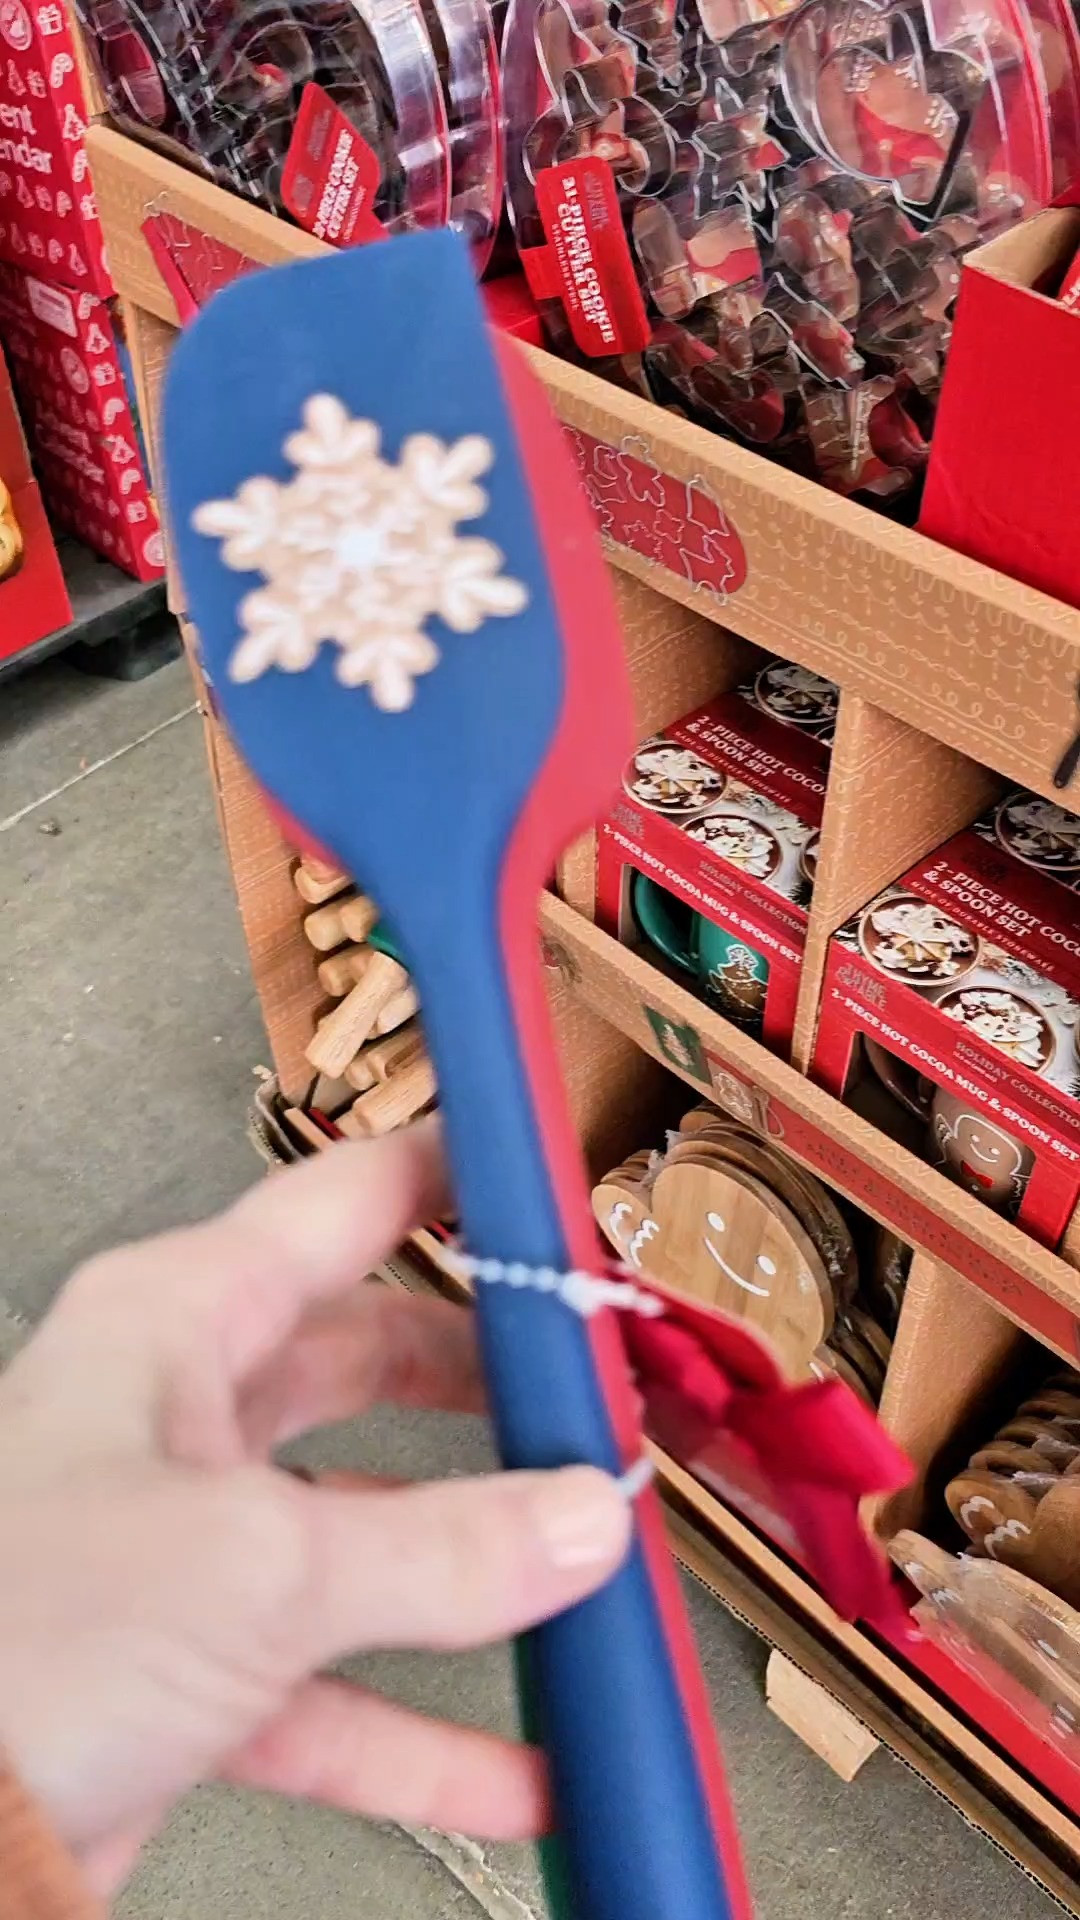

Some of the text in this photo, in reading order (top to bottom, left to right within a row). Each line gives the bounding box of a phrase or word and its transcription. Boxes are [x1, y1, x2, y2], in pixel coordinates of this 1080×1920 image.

[327, 184, 352, 238] CUTTER
[342, 156, 359, 188] SET
[558, 203, 600, 324] CUTTER SET
[584, 267, 616, 343] COOKIE
[675, 731, 697, 746] MADE
[696, 745, 709, 753] OF
[686, 722, 775, 777] & SPOON SET
[751, 749, 786, 769] HOT
[641, 851, 665, 873] HOT
[664, 866, 702, 899] COCOA
[701, 893, 730, 917] MUG
[729, 911, 740, 925] &
[739, 919, 780, 950] SPOON
[779, 945, 802, 963] SET
[700, 860, 744, 893] HOLIDAY
[744, 890, 808, 935] COLLECTION
[911, 881, 1056, 972] MADE OF DURABLE STONEWARE
[923, 870, 1032, 937] & SPOON SET
[1000, 901, 1042, 927] HOT
[880, 1022, 910, 1047] HOT
[909, 1043, 954, 1080] COCOA
[954, 1074, 989, 1101] MUG
[988, 1098, 1001, 1112] &
[1000, 1105, 1052, 1143] SPOON
[1050, 1139, 1080, 1161] SET
[955, 1041, 1010, 1081] HOLIDAY
